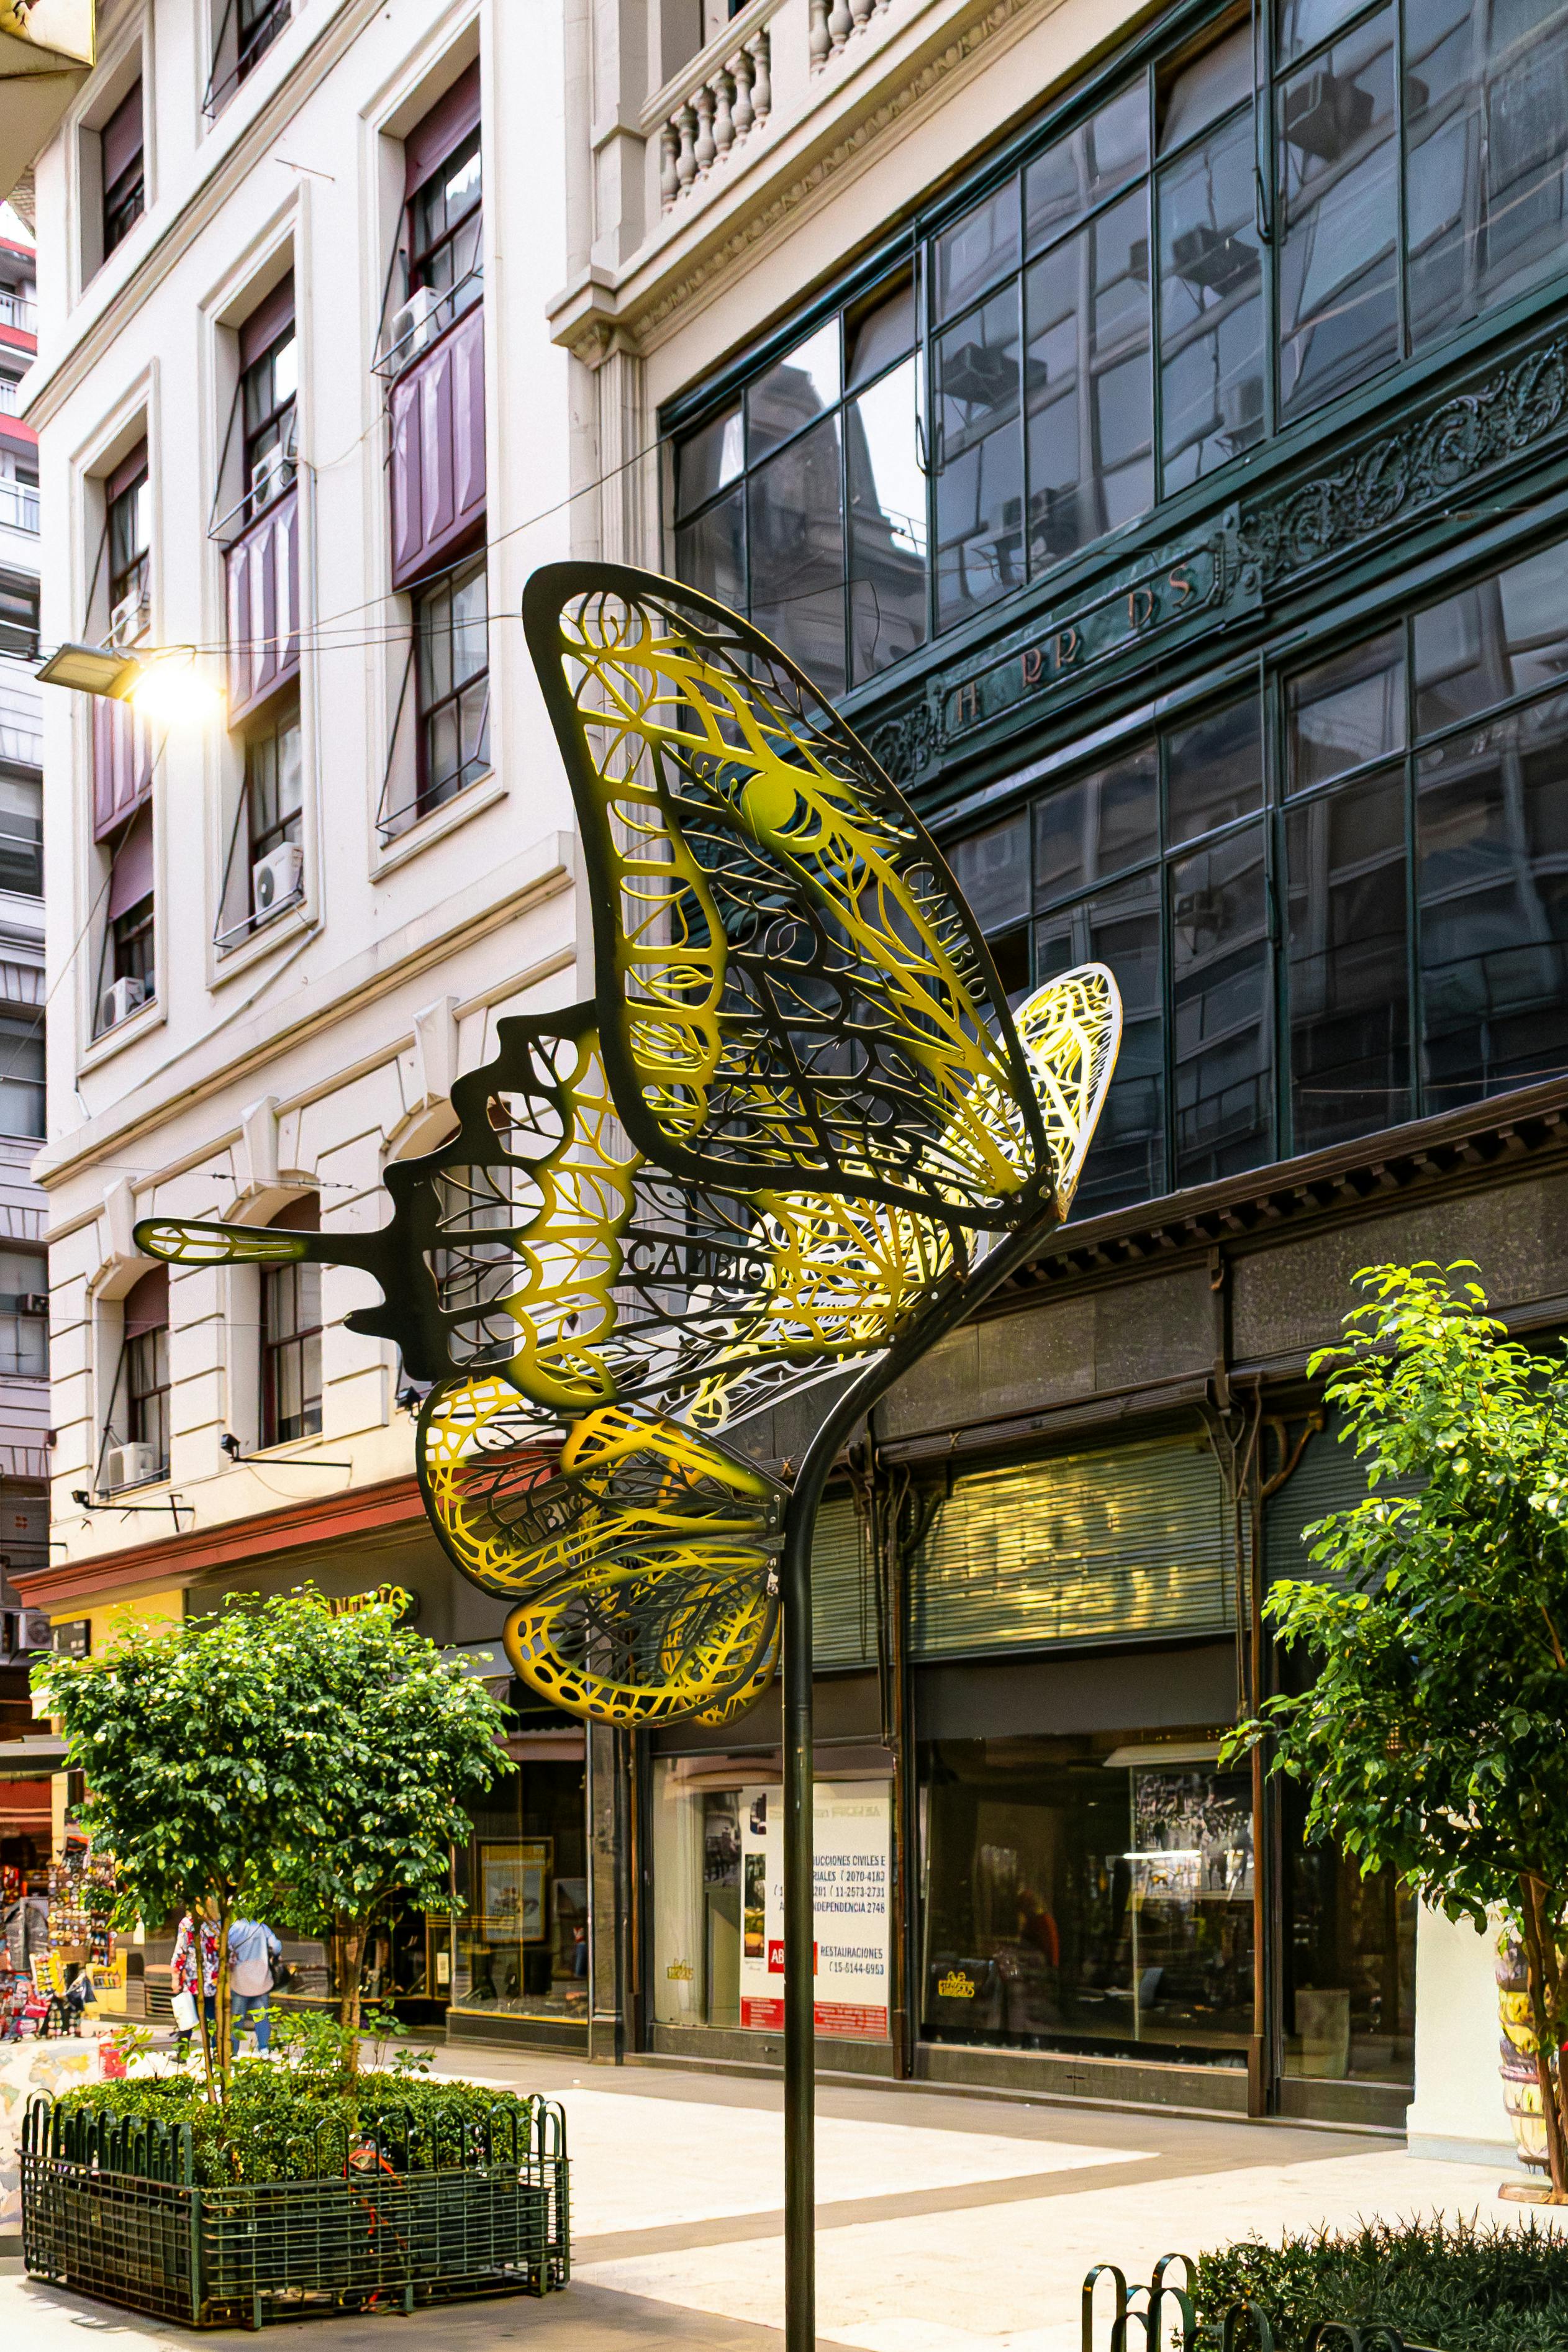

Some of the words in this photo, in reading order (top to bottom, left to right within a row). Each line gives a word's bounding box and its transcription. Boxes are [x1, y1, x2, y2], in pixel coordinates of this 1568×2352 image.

[813, 1855, 851, 1866] UCCIONES
[853, 1856, 879, 1866] CIVILES
[881, 1856, 886, 1866] E
[813, 1871, 836, 1881] RIALES
[813, 1902, 866, 1912] NDEPENDENCIA
[820, 1946, 883, 1959] RESTAURACIONES
